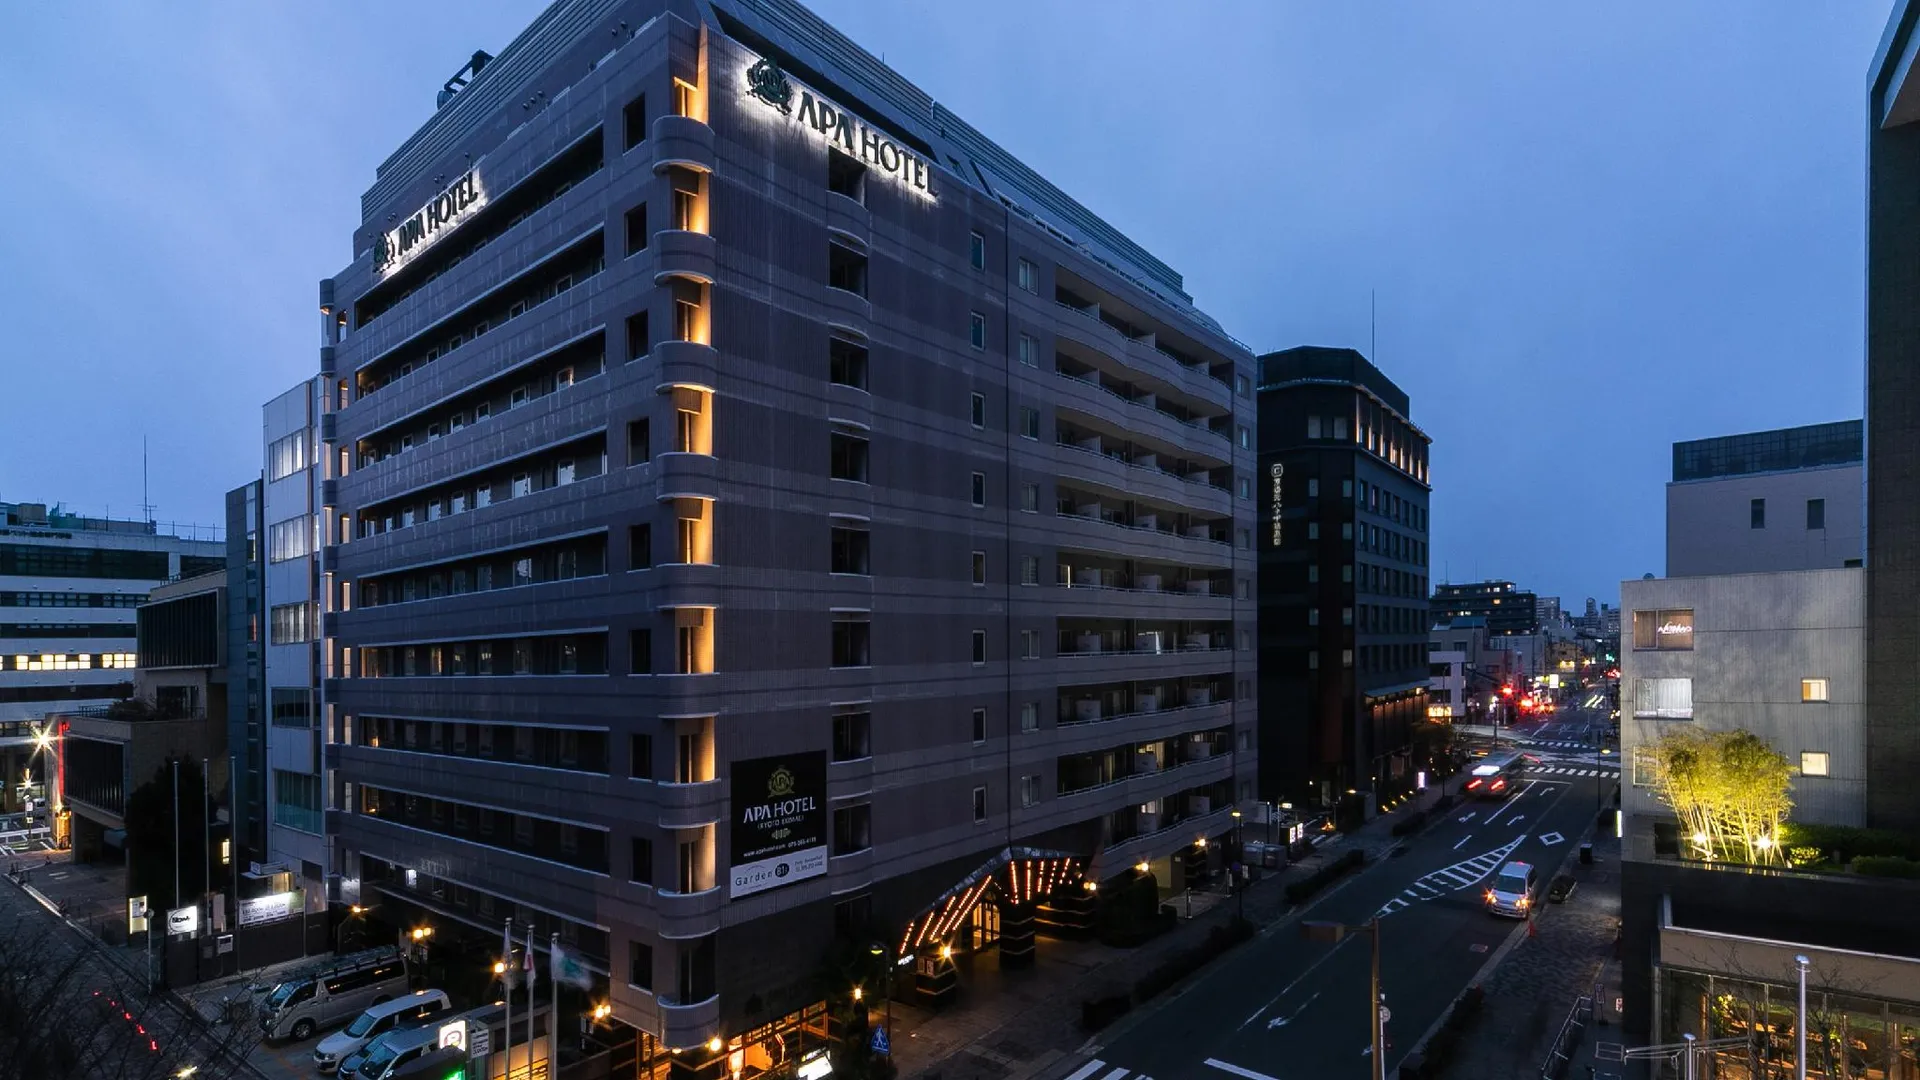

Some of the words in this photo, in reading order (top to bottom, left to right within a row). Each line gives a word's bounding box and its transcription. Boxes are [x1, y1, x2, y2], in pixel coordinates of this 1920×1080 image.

[797, 91, 854, 151] APA
[860, 127, 939, 197] HOTEL
[398, 213, 426, 255] APA
[427, 172, 479, 234] HOTEL
[743, 805, 772, 823] APA
[774, 796, 816, 817] HOTEL
[735, 871, 772, 886] Garden
